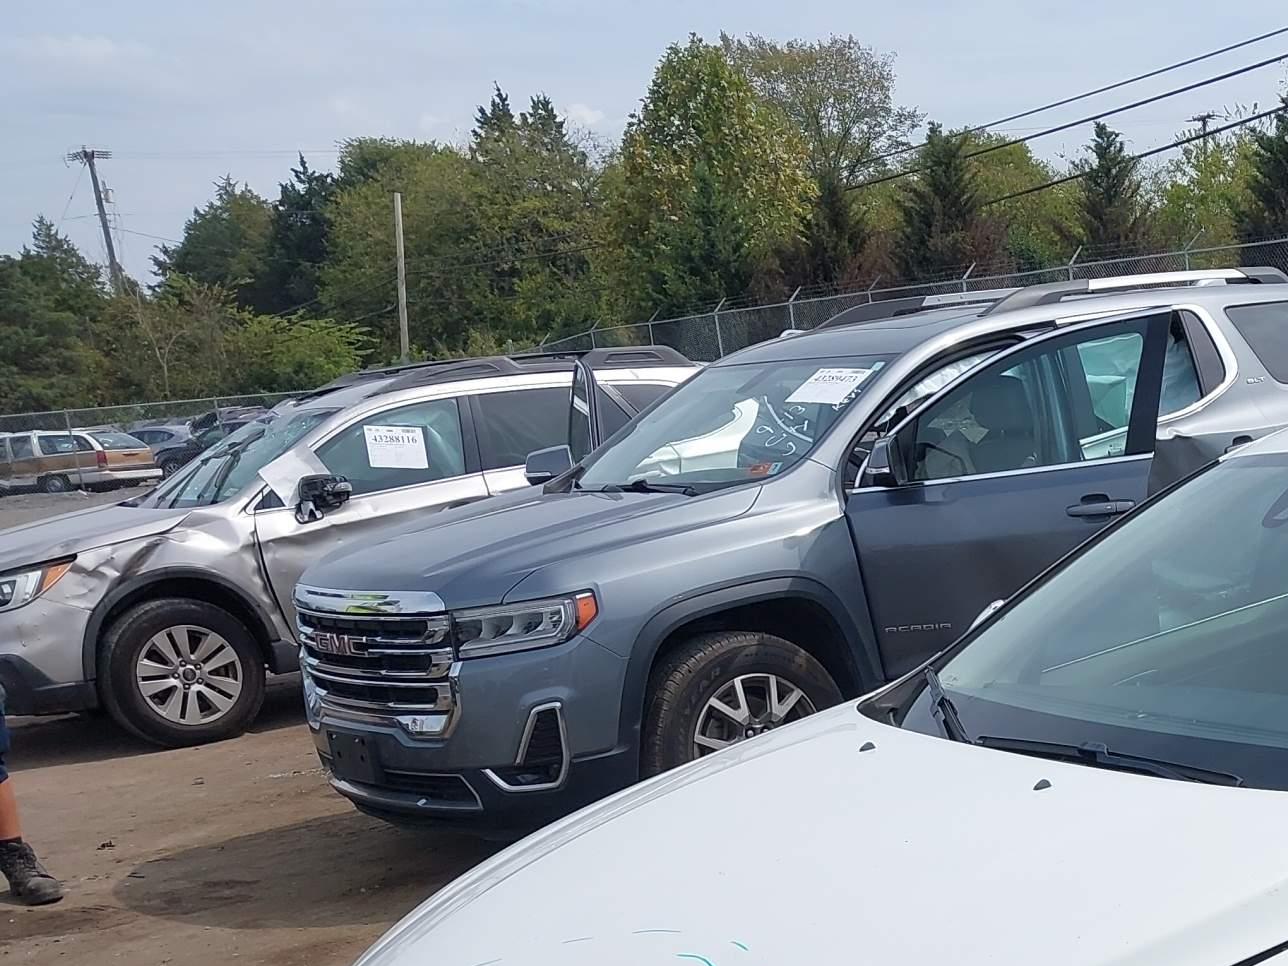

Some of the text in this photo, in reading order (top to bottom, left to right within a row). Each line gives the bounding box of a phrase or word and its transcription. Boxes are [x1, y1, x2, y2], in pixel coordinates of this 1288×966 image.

[371, 434, 418, 445] 43288116
[885, 622, 952, 633] ACADIA
[313, 632, 369, 658] GMC
